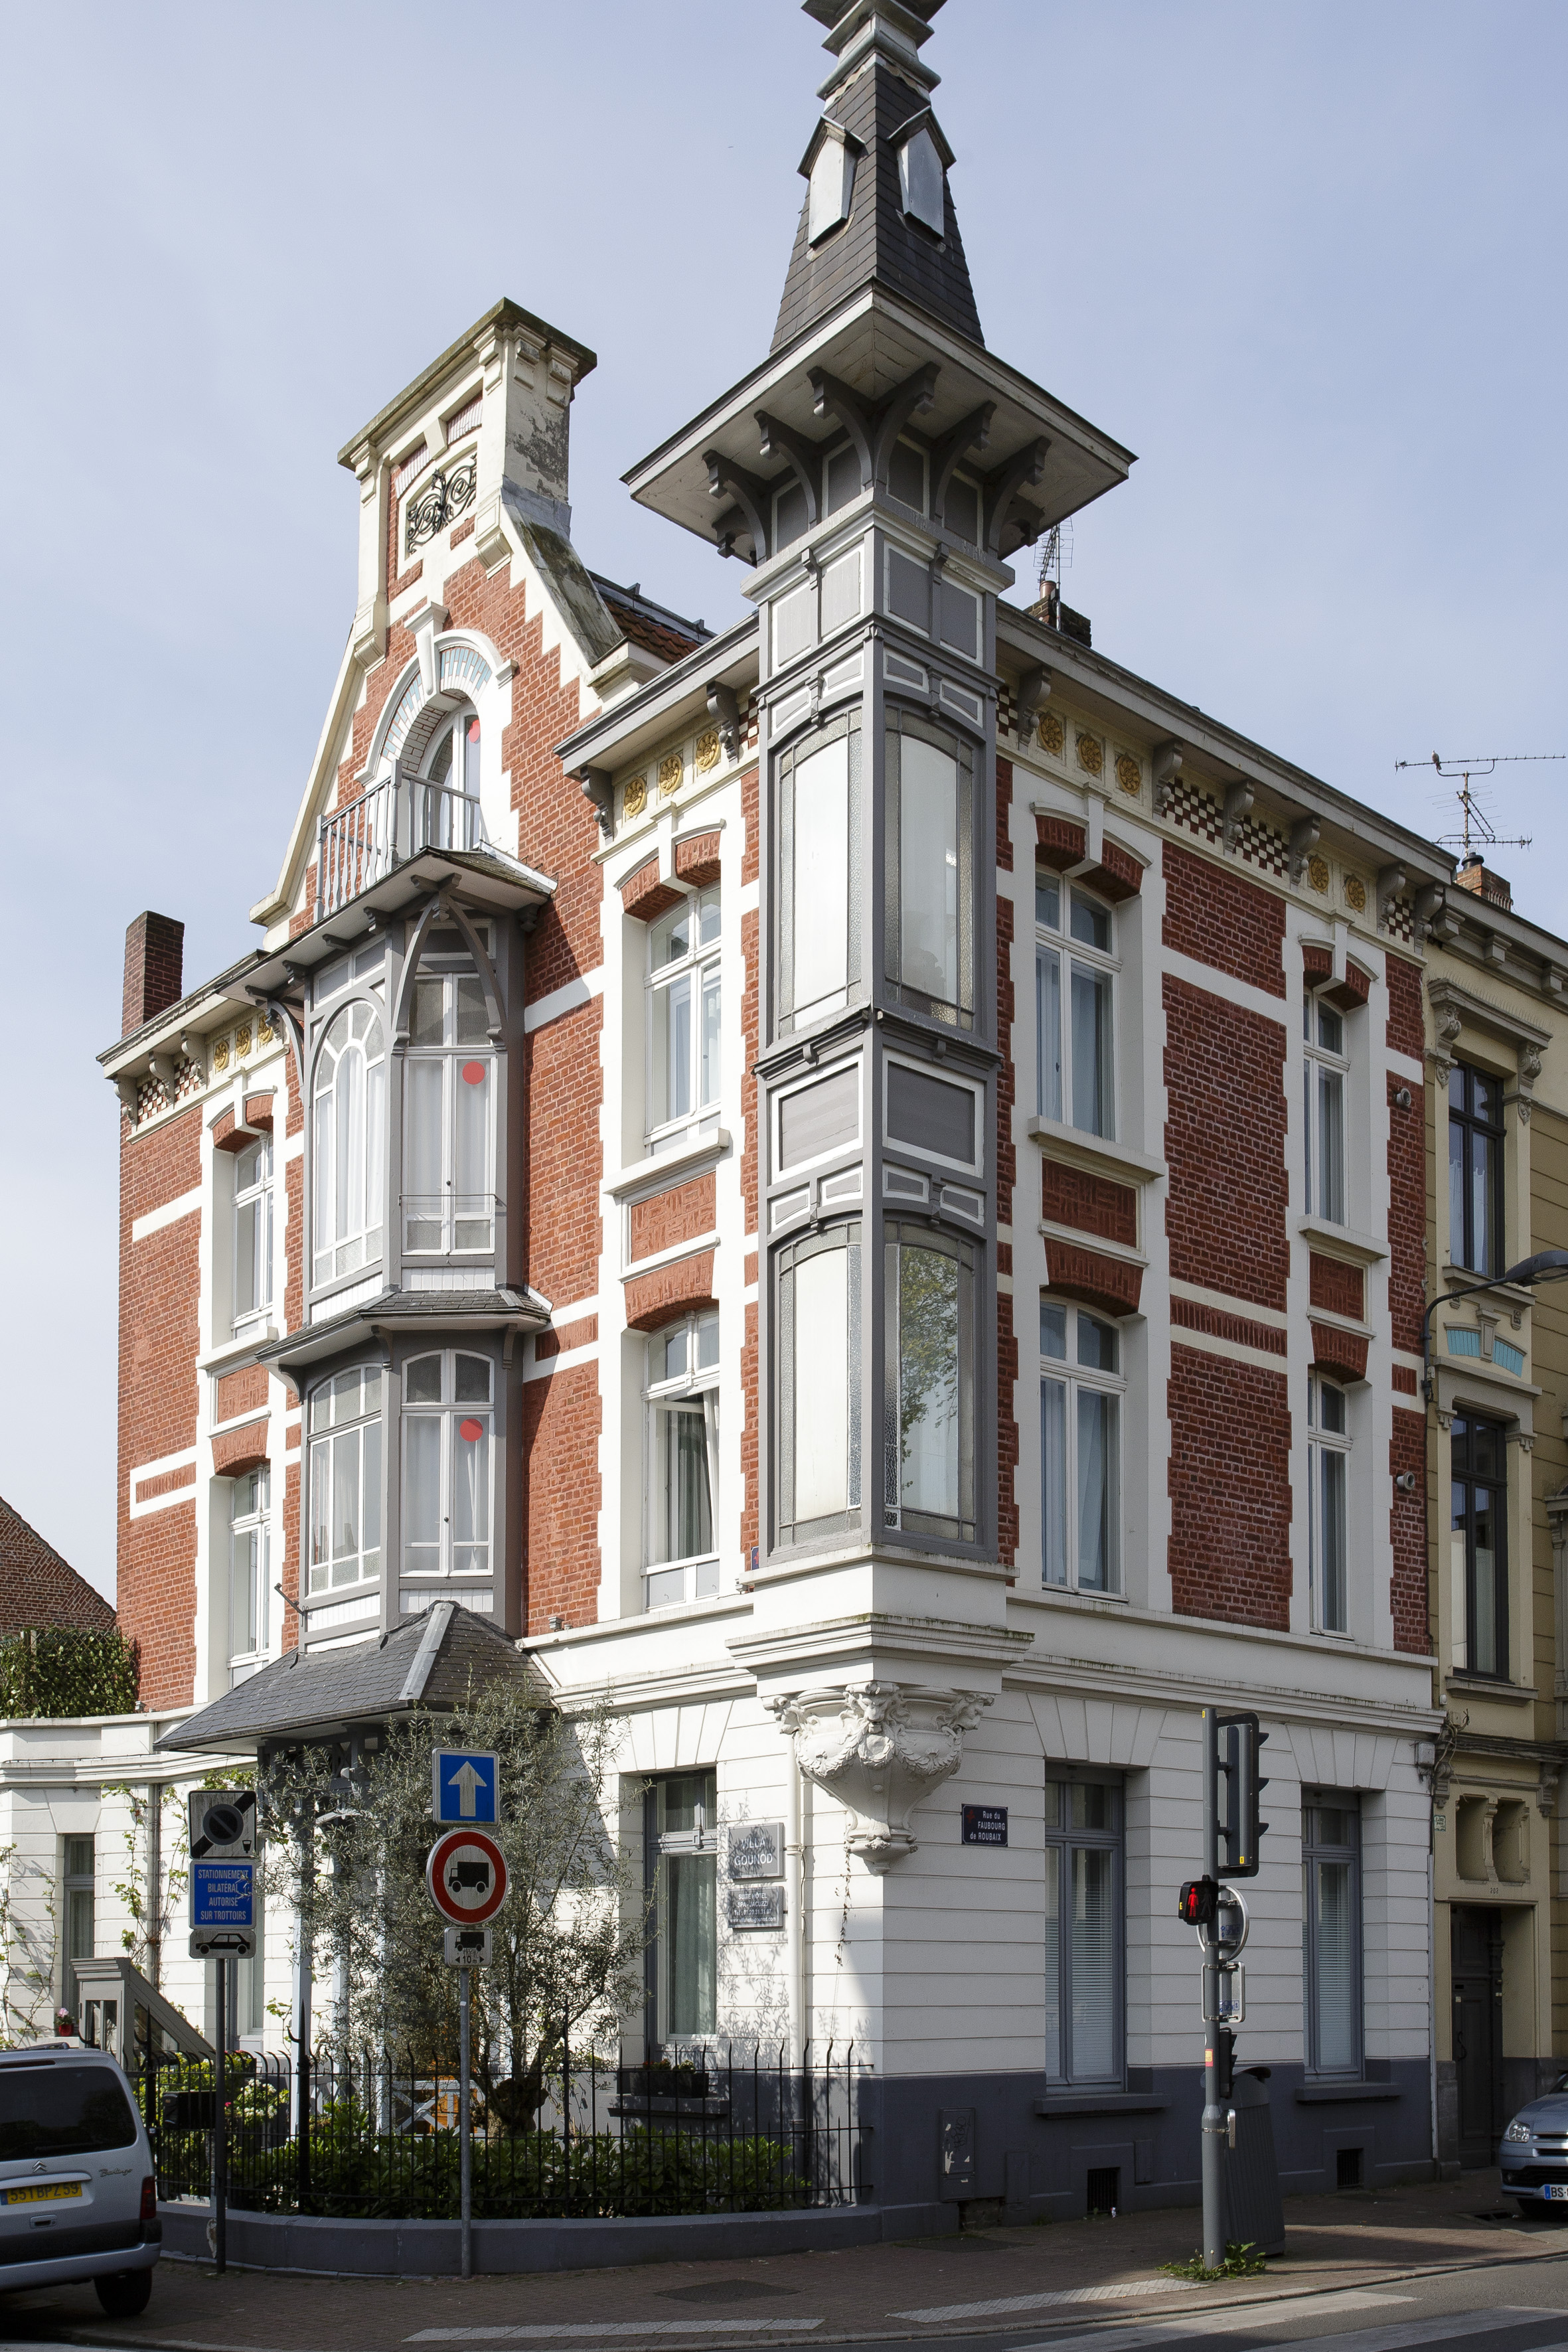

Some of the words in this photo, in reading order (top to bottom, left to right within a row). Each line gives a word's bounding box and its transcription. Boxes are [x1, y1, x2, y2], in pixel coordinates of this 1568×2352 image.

[982, 1810, 992, 1819] Rue
[977, 1821, 1006, 1830] FAUBOURG
[978, 1832, 1001, 1841] ROUBAIX
[741, 1837, 765, 1849] VILLA
[734, 1853, 773, 1866] GOUNOD
[198, 1869, 249, 1879] STATIONNEMENT
[207, 1881, 239, 1893] BILATÉRAL
[200, 1911, 212, 1920] SUR
[214, 1911, 246, 1921] TROTTOIRS
[462, 1955, 472, 1964] 10
